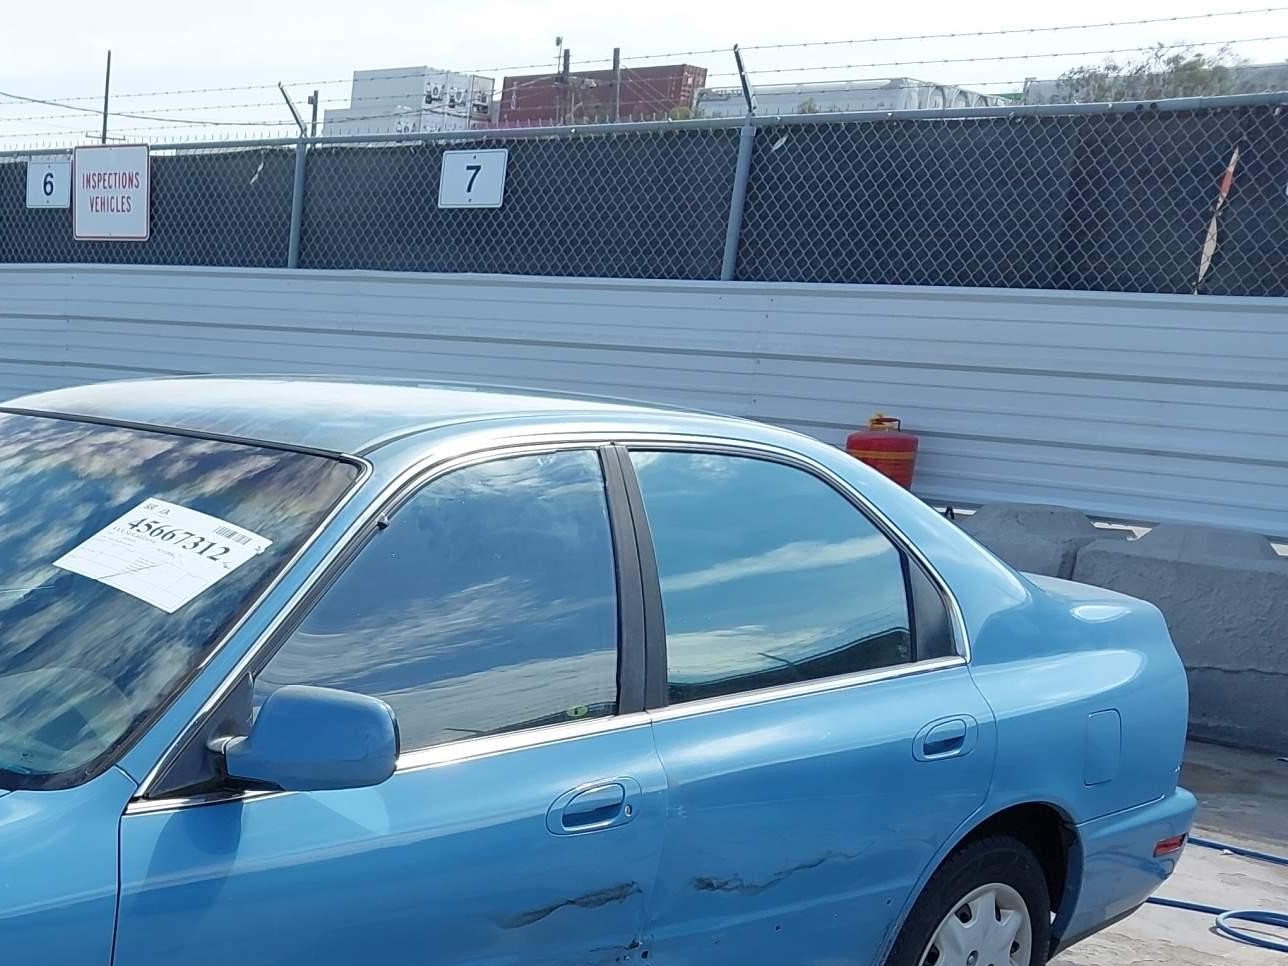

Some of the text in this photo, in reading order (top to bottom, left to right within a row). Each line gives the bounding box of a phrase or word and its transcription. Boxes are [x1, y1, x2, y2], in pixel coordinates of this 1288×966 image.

[43, 173, 54, 196] 6
[82, 171, 140, 190] INSPECTIONS
[466, 165, 481, 193] 7
[90, 195, 132, 213] VEHICLES
[128, 517, 231, 561] 45667312
